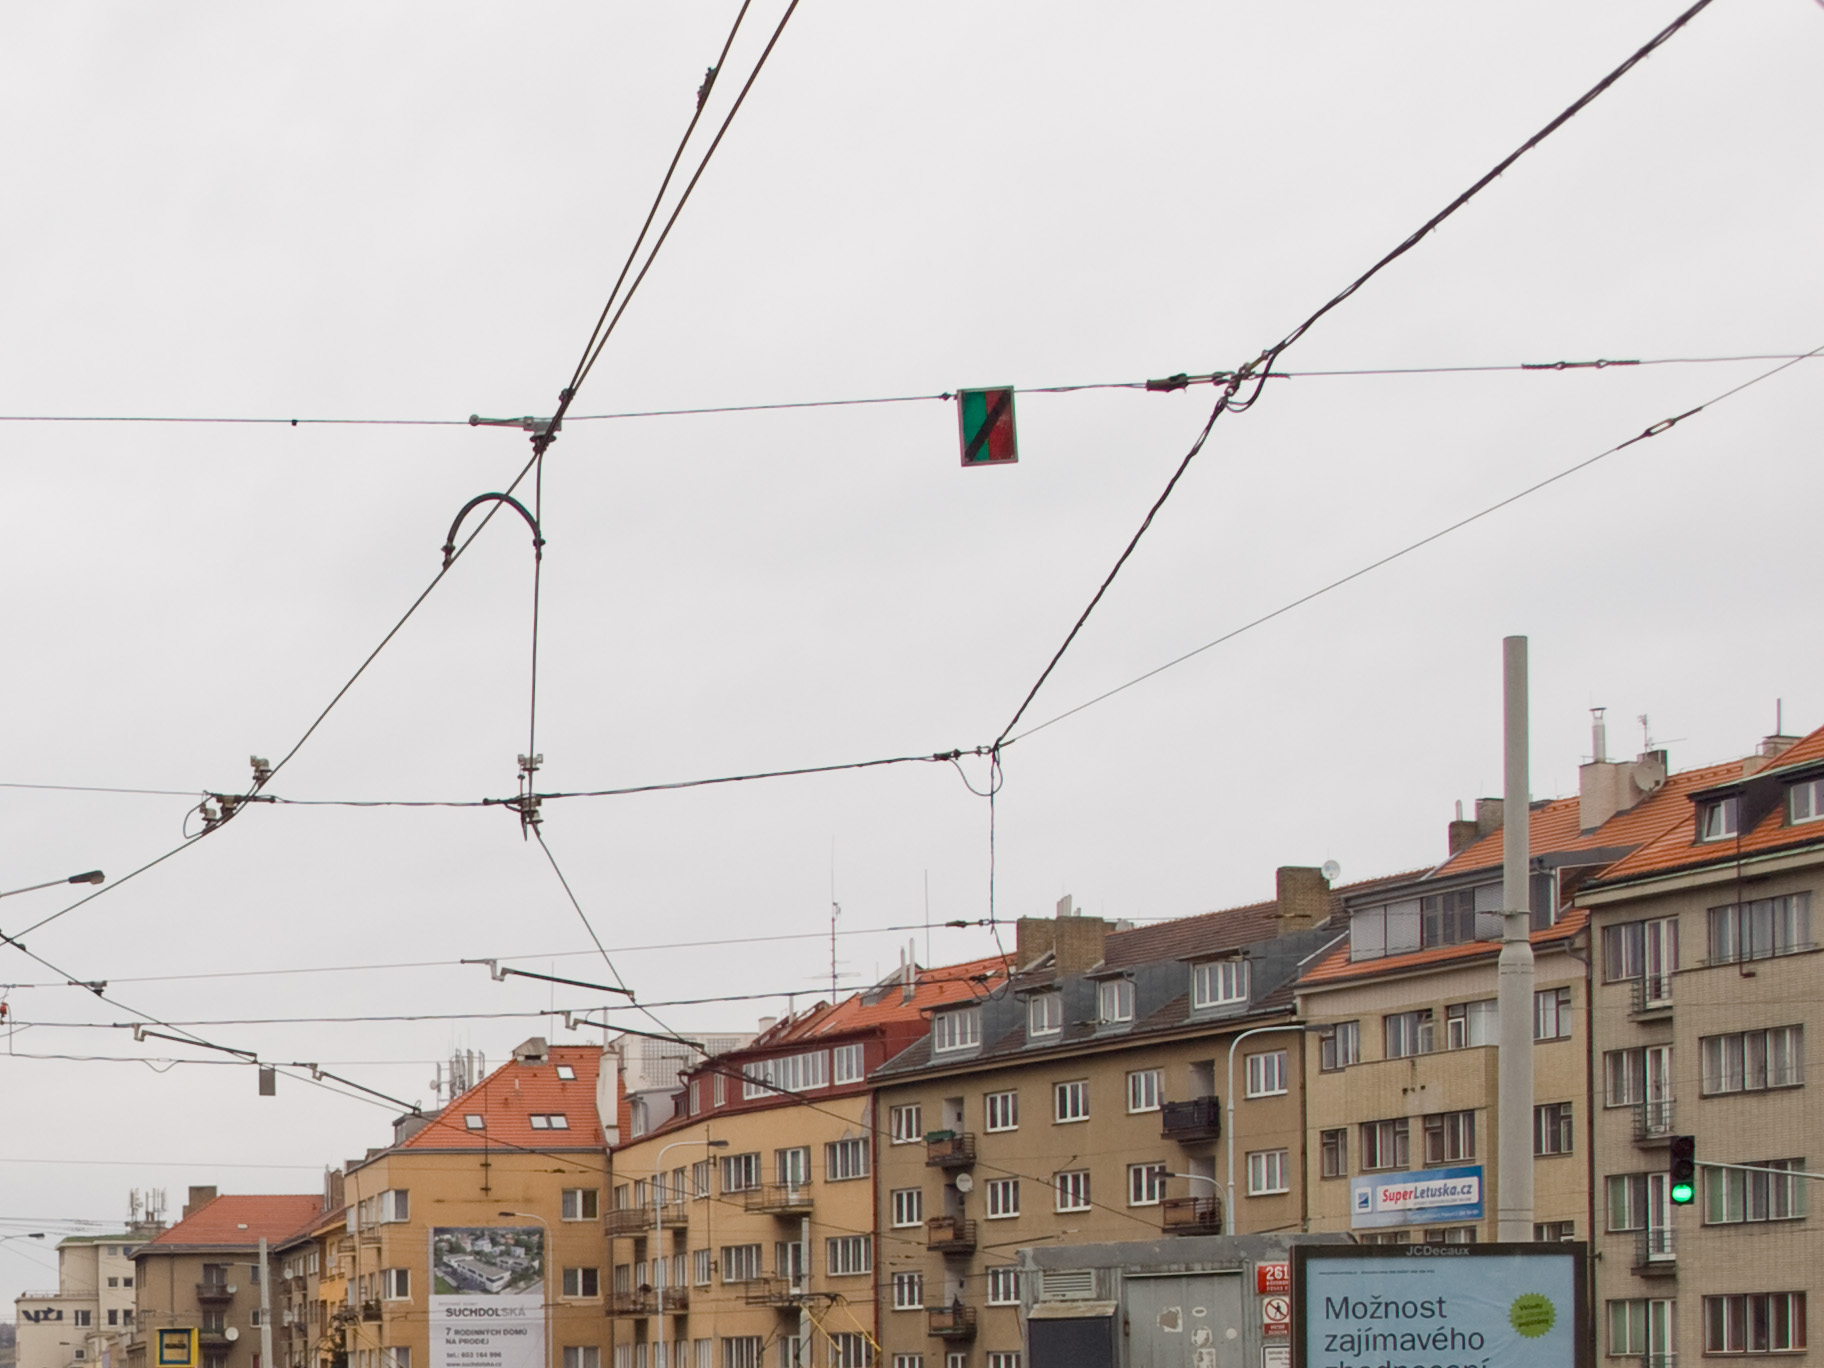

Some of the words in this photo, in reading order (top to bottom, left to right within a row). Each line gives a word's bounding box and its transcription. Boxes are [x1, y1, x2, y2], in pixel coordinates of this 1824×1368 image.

[1382, 1183, 1473, 1205] SuperLetuska.cz
[1406, 1245, 1470, 1256] JCDecaux
[445, 1304, 526, 1317] SUCHDOLSKÁ
[1325, 1295, 1447, 1320] Možnost
[1324, 1326, 1485, 1357] zajímavého
